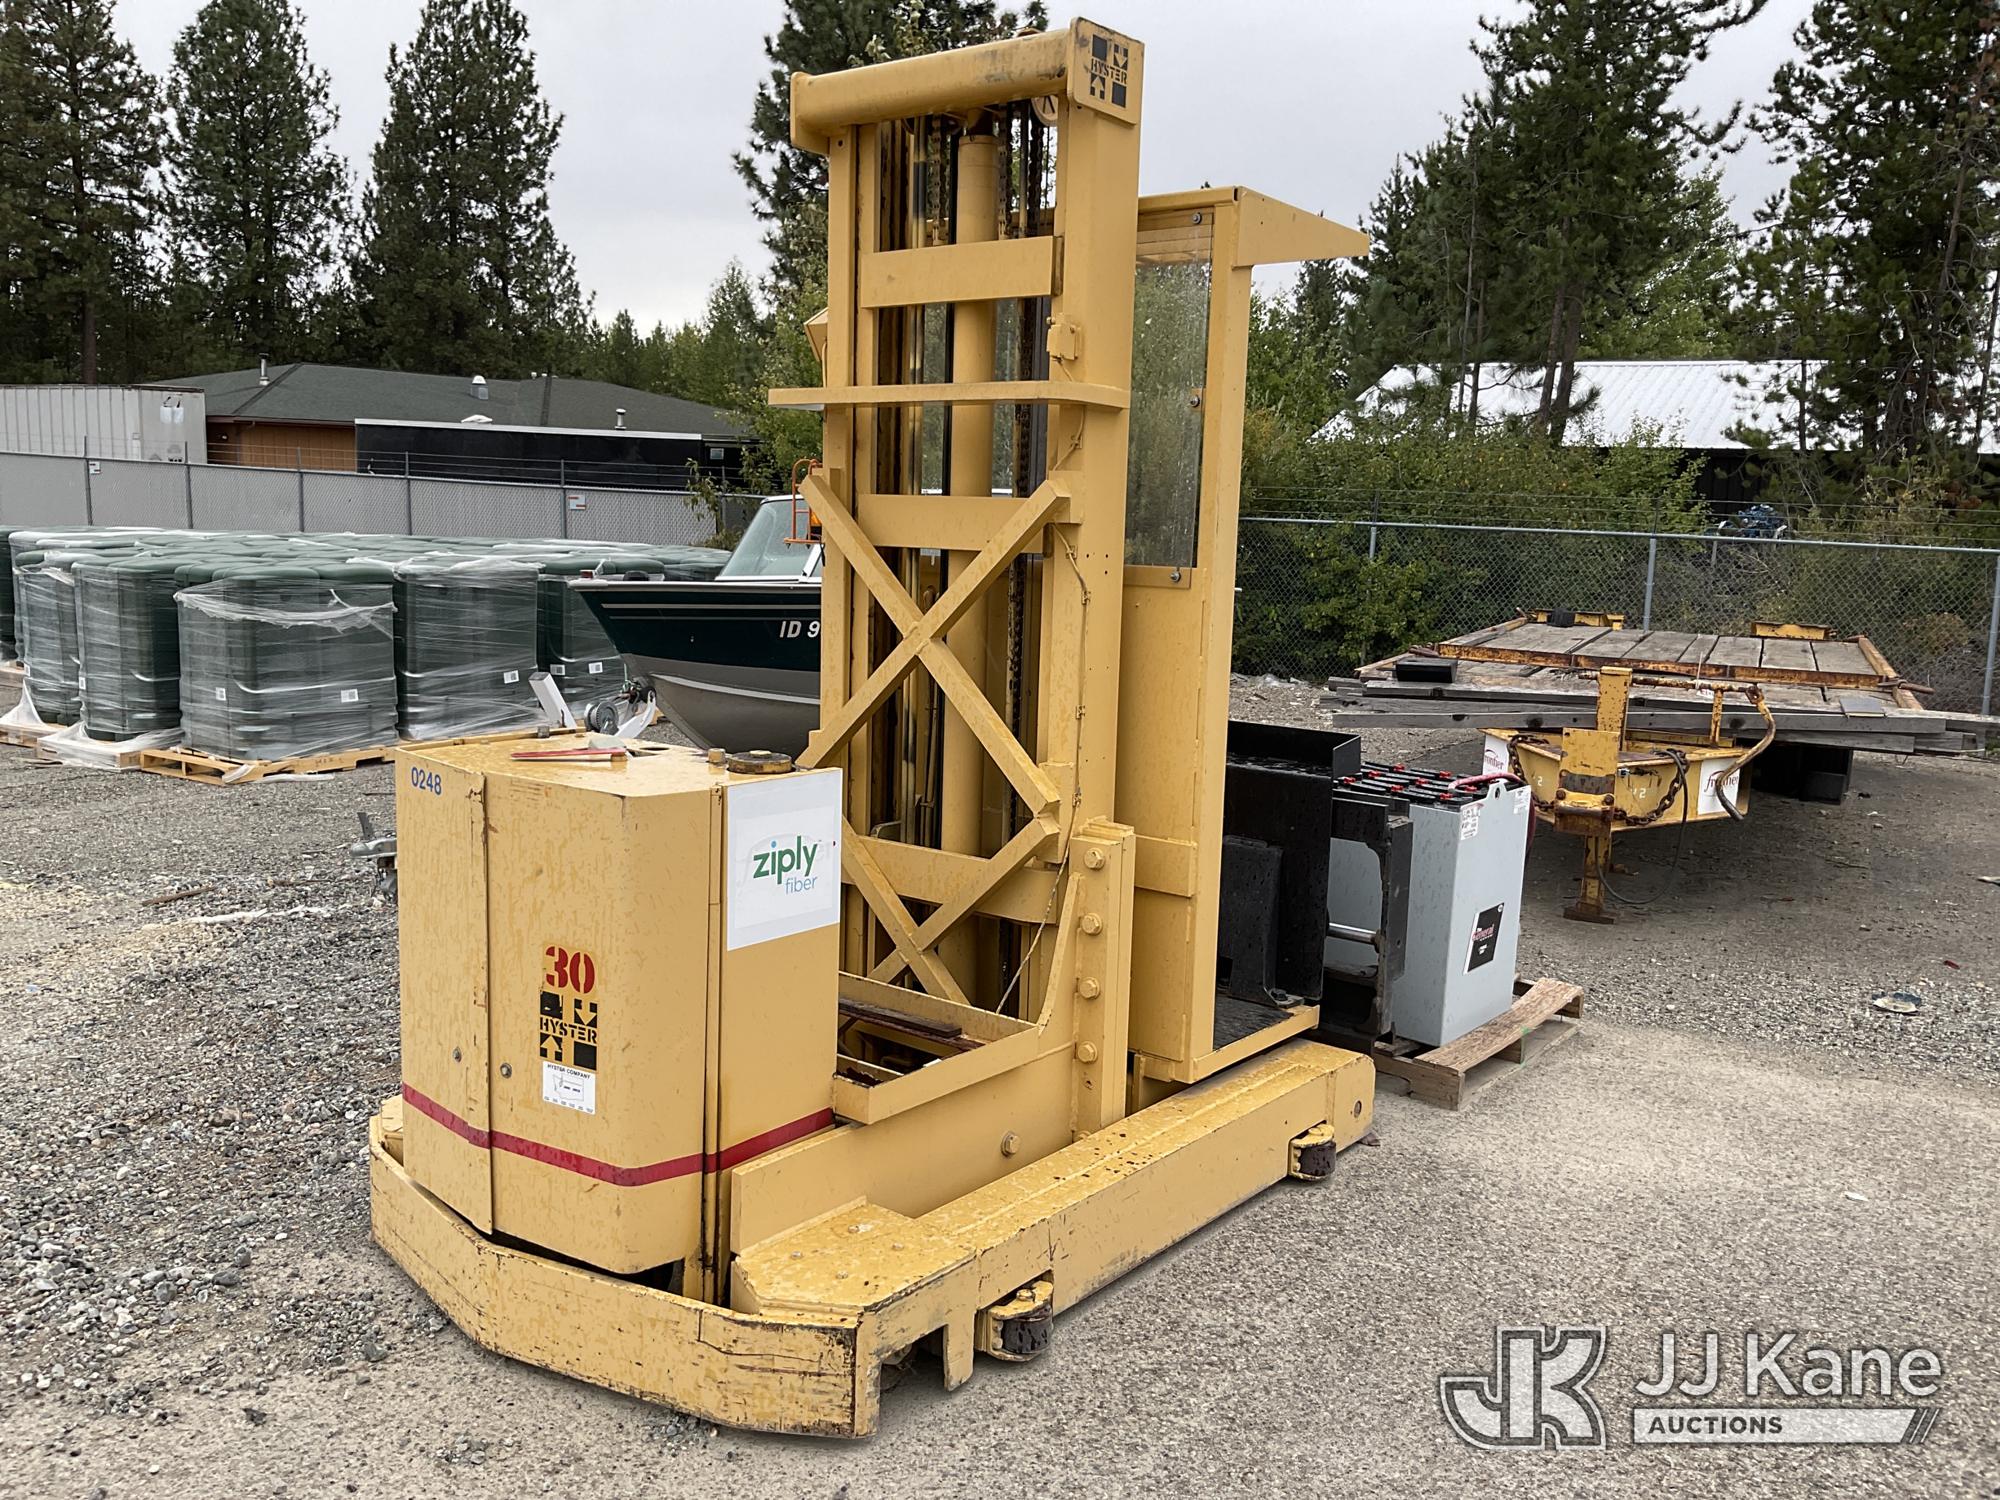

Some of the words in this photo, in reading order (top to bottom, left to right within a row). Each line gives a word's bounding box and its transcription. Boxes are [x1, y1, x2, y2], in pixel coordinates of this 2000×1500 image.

[1091, 58, 1127, 85] HYSTER
[779, 620, 802, 638] ID
[807, 620, 821, 638] 9
[411, 766, 442, 796] 0248
[753, 835, 818, 885] ziply
[785, 876, 818, 895] fiber
[545, 946, 596, 994] 30
[540, 1016, 598, 1045] HYSTER
[566, 1068, 591, 1080] COMPANY
